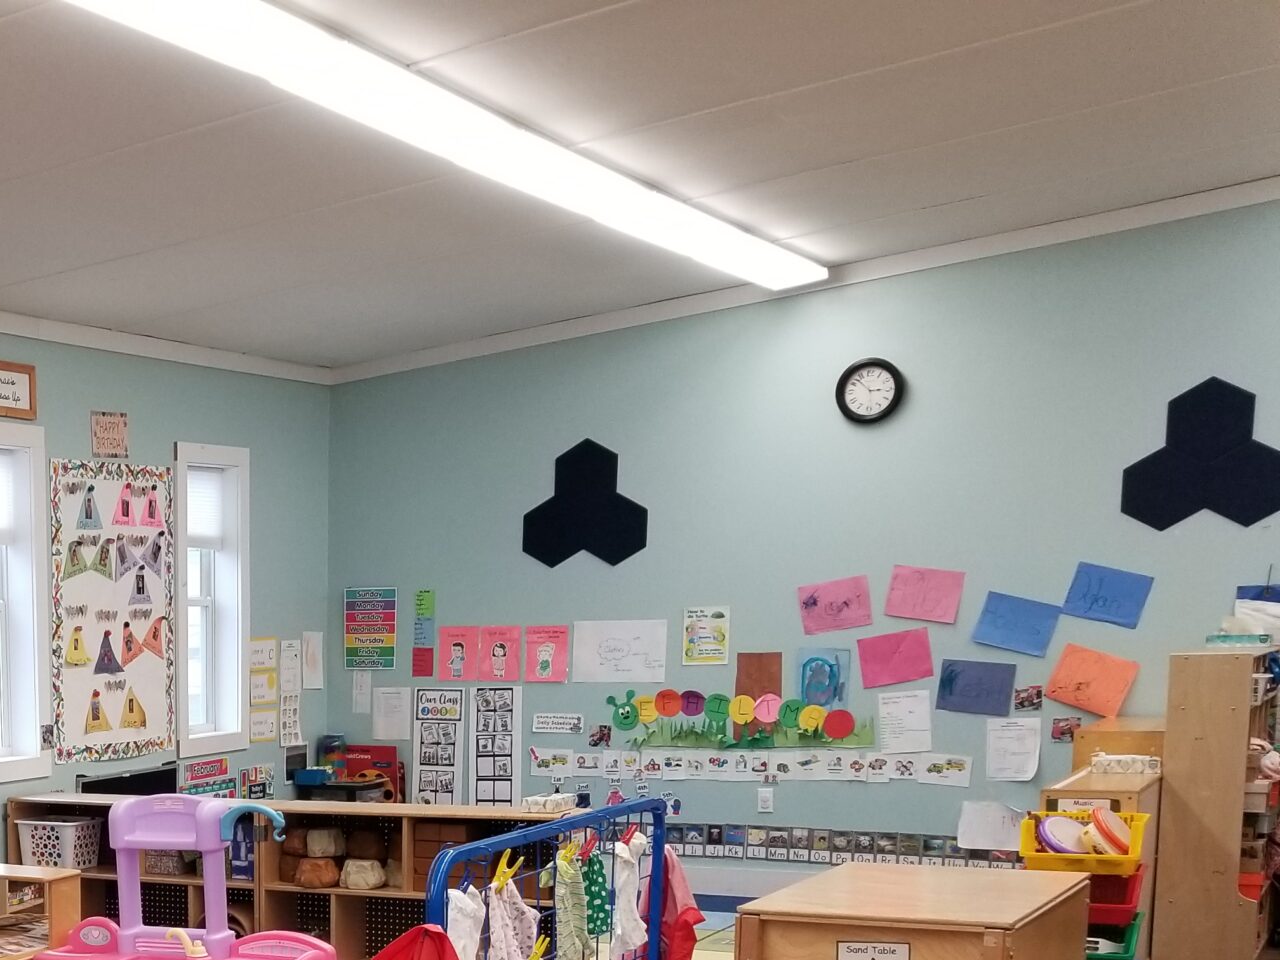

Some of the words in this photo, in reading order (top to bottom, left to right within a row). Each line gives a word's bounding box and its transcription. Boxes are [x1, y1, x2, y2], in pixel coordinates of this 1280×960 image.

[12, 390, 20, 406] Up
[98, 420, 120, 434] HAPPY
[96, 436, 126, 450] BIRTHDAY
[357, 590, 382, 599] Sunday
[356, 602, 384, 611] Monday
[356, 613, 383, 622] Tuesday
[350, 625, 388, 633] Wednesday
[354, 637, 384, 645] Thursday
[358, 648, 379, 657] Friday
[354, 659, 383, 667] Saturday
[420, 692, 436, 704] Our
[439, 692, 458, 705] Class
[639, 701, 653, 717] E
[661, 696, 675, 711] F
[687, 695, 699, 711] H
[738, 701, 750, 715] L
[760, 699, 778, 715] T
[783, 705, 799, 720] M
[193, 763, 220, 775] February
[728, 847, 739, 856] Kk
[770, 850, 786, 858] Mm
[793, 852, 805, 860] Nn
[814, 853, 826, 861] Oo
[836, 854, 847, 864] Pp
[846, 946, 868, 954] Sand
[872, 946, 897, 955] Table
